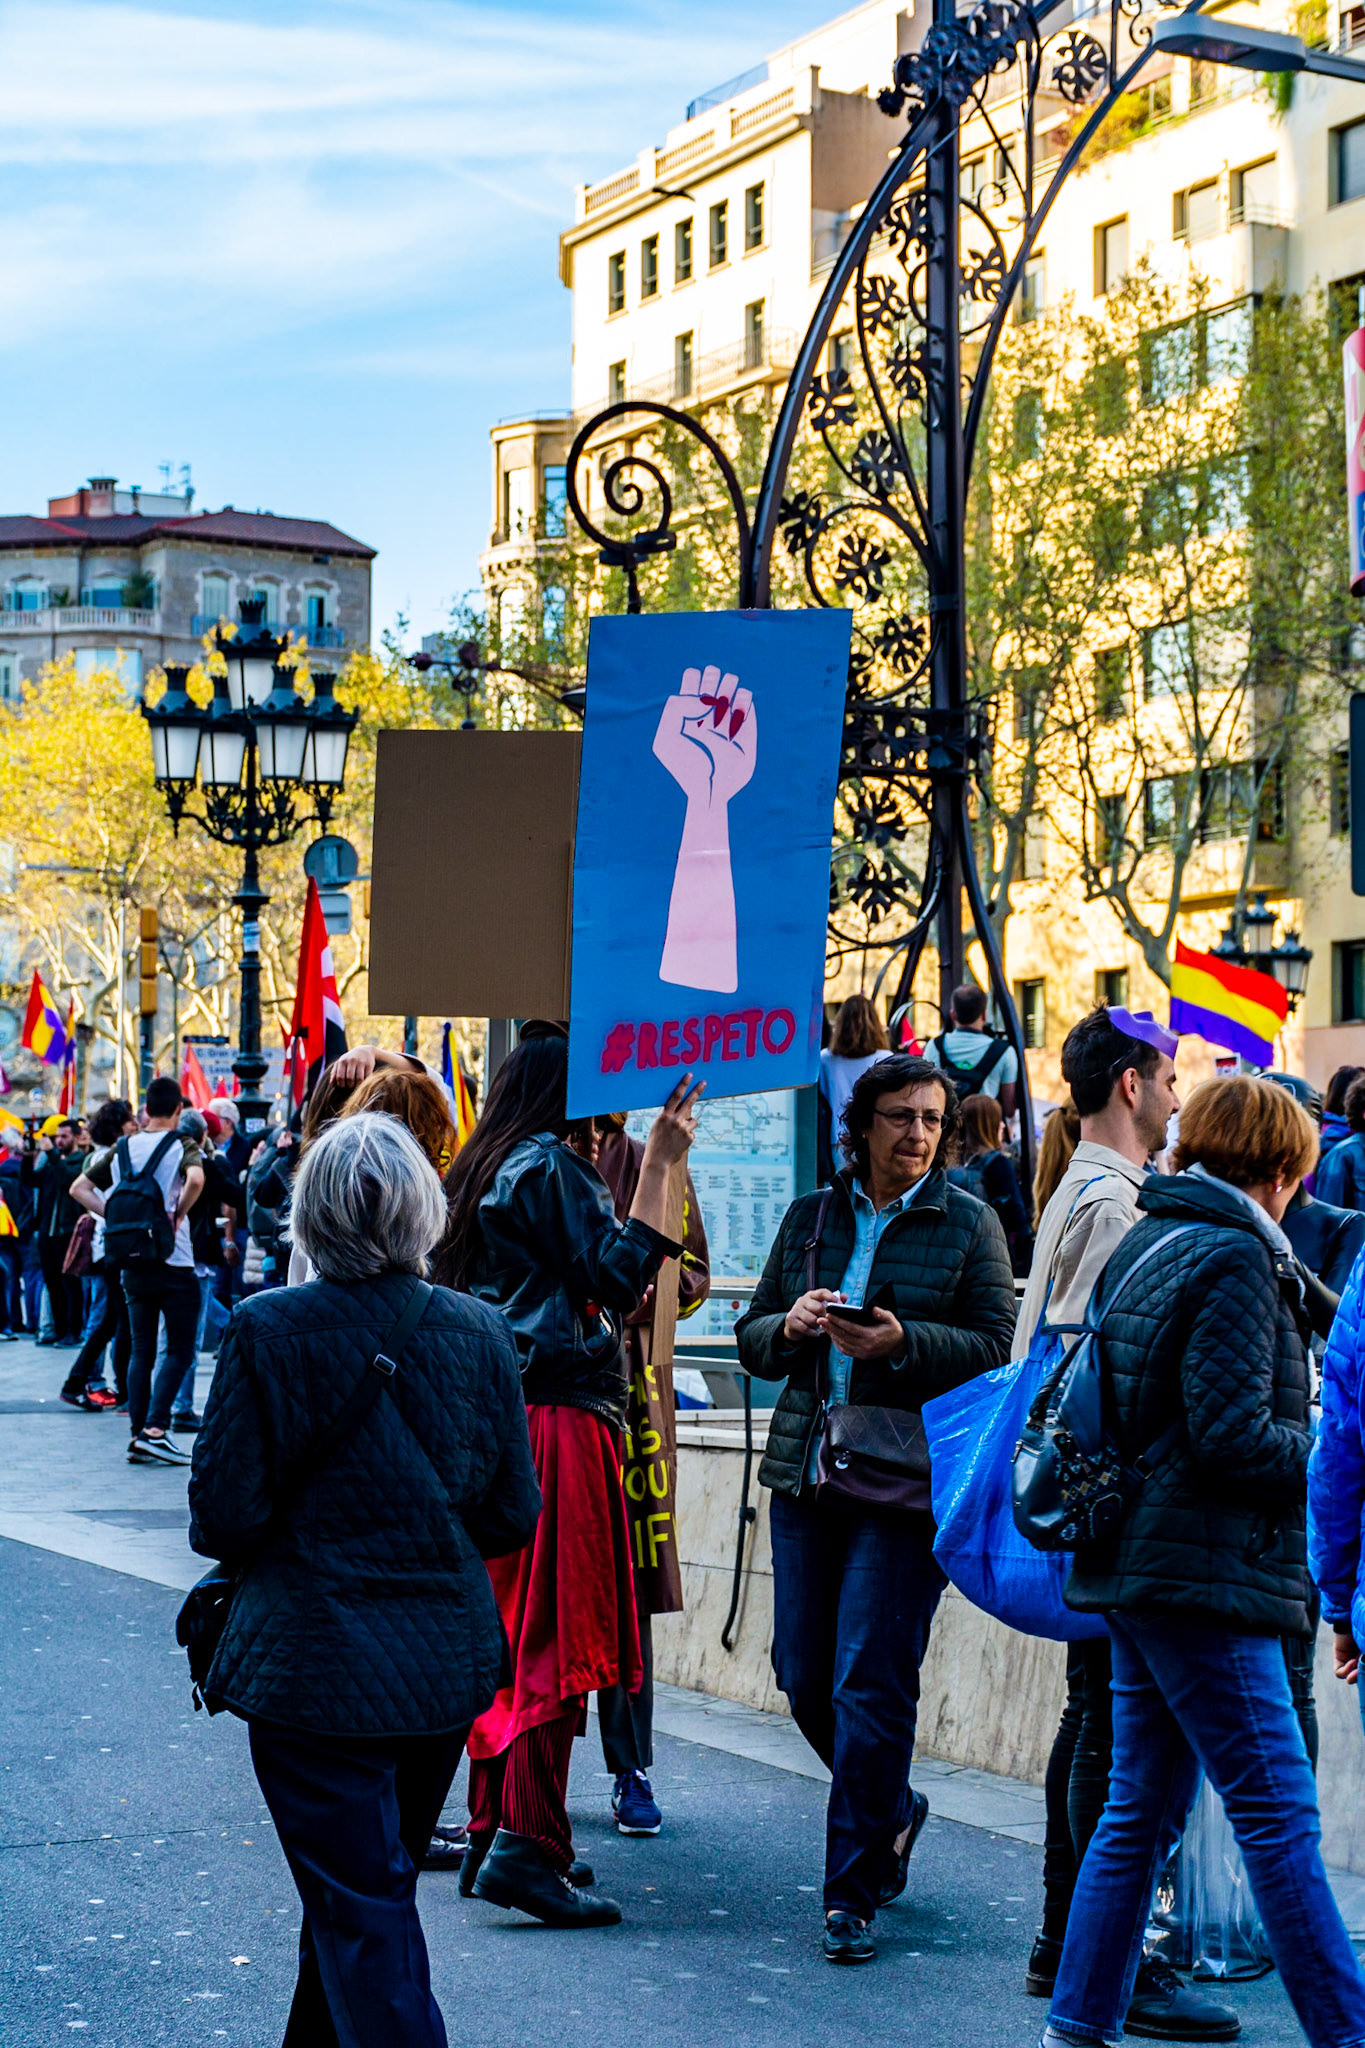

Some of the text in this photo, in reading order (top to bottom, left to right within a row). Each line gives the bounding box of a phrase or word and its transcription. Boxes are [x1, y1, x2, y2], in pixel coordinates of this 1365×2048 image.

[600, 1007, 796, 1074] #RESPETO
[620, 1459, 671, 1501] OU
[632, 1512, 677, 1568] IF
